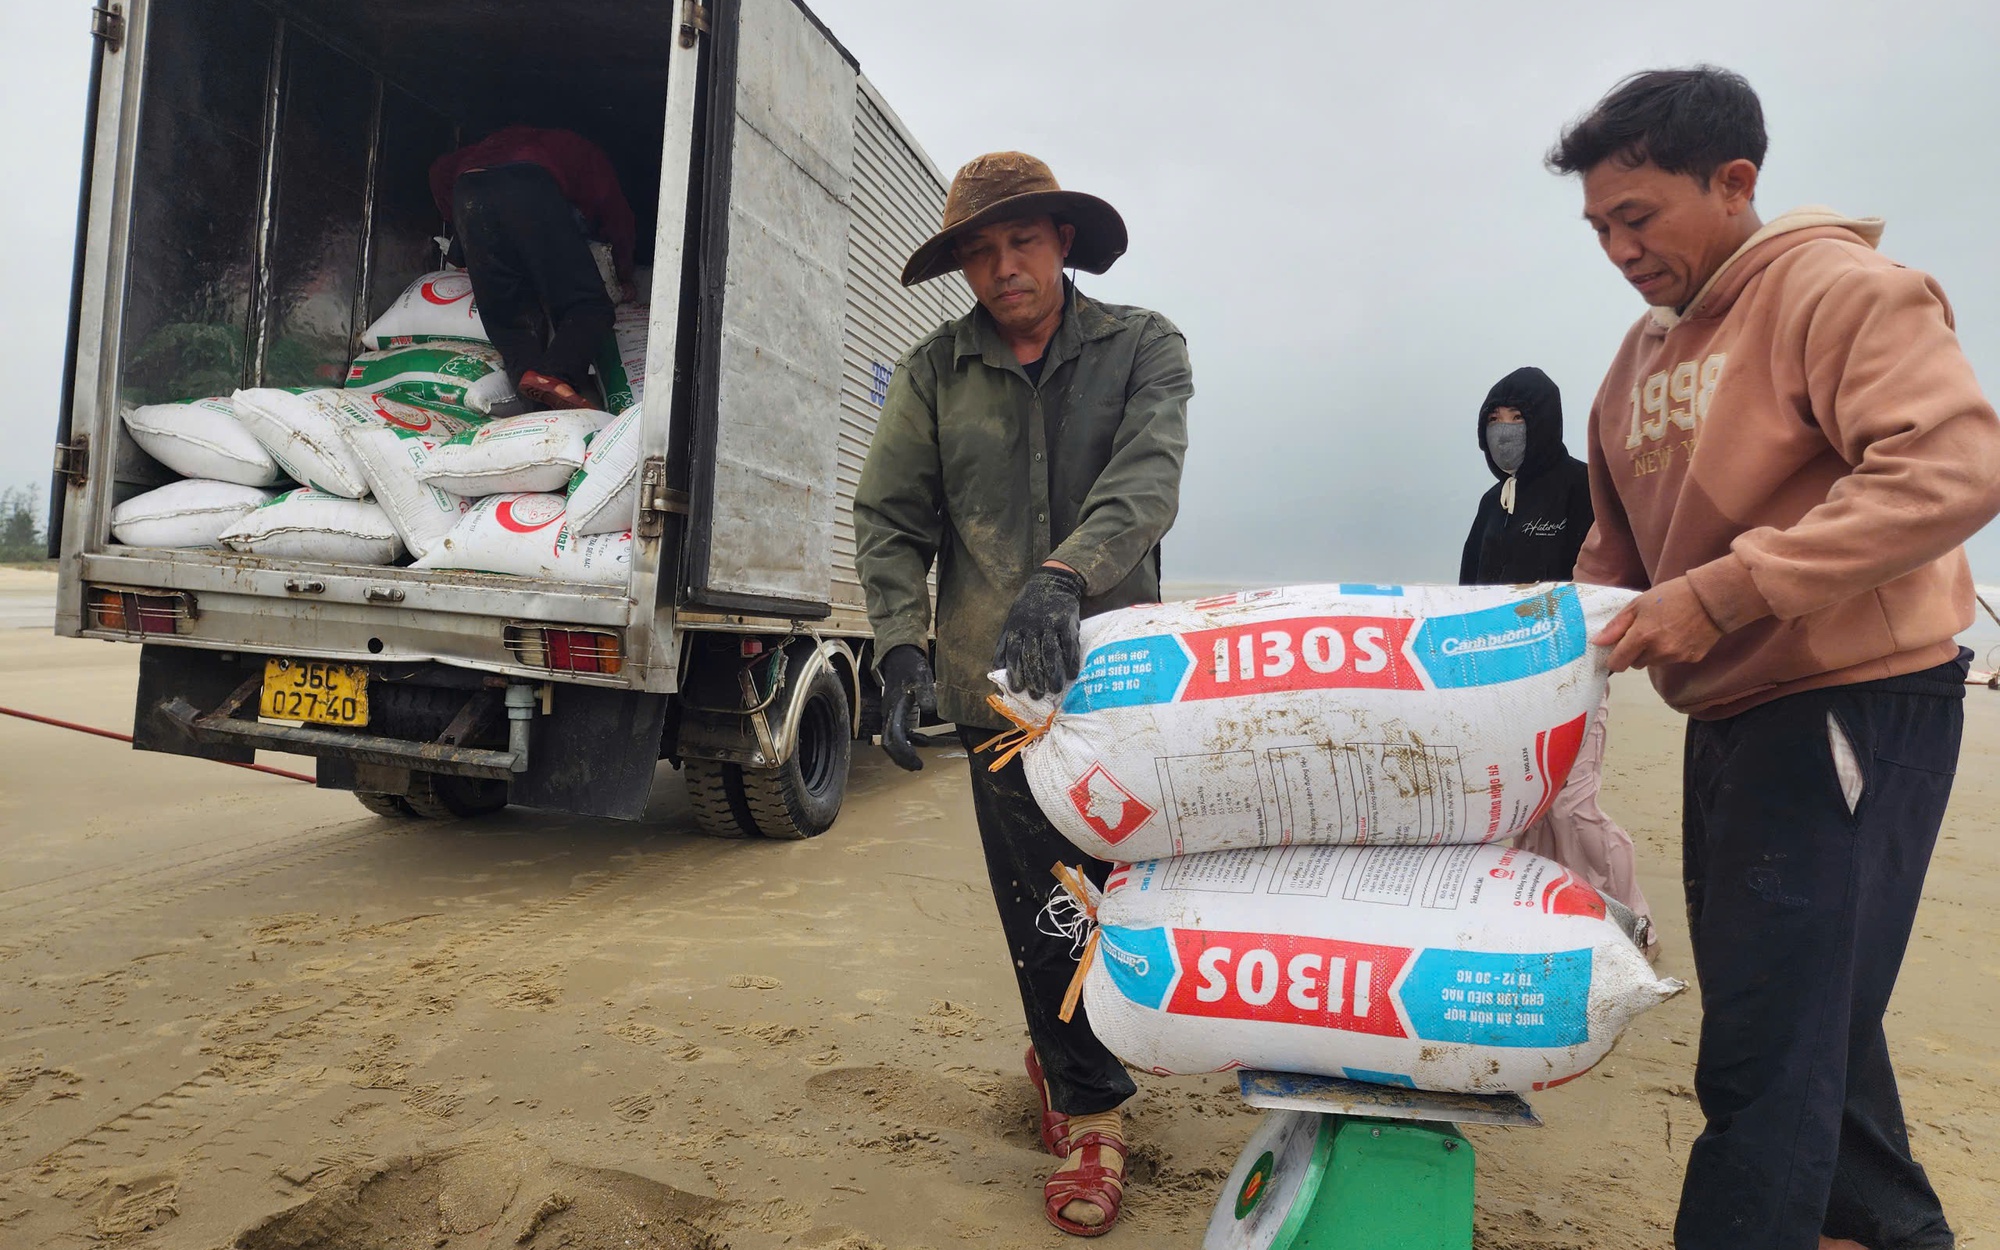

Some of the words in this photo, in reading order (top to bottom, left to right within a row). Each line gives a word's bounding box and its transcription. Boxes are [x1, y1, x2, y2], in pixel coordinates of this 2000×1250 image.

[1633, 445, 1674, 478] NEW
[1213, 626, 1388, 683] 1130S
[294, 663, 339, 690] 36C
[1108, 663, 1130, 676] SIÊU
[1094, 683, 1103, 693] 12
[1112, 680, 1124, 691] 30
[1126, 678, 1140, 690] KG
[272, 691, 357, 721] 027.40
[1197, 946, 1373, 1018] 1130S
[1456, 970, 1472, 983] KG
[1476, 972, 1491, 984] 30
[1502, 972, 1515, 985] 12
[1442, 985, 1464, 1002] NẠC
[1467, 990, 1493, 1006] SIÊU
[1444, 1005, 1467, 1022] HỢP
[1515, 1012, 1545, 1028] THỨC
